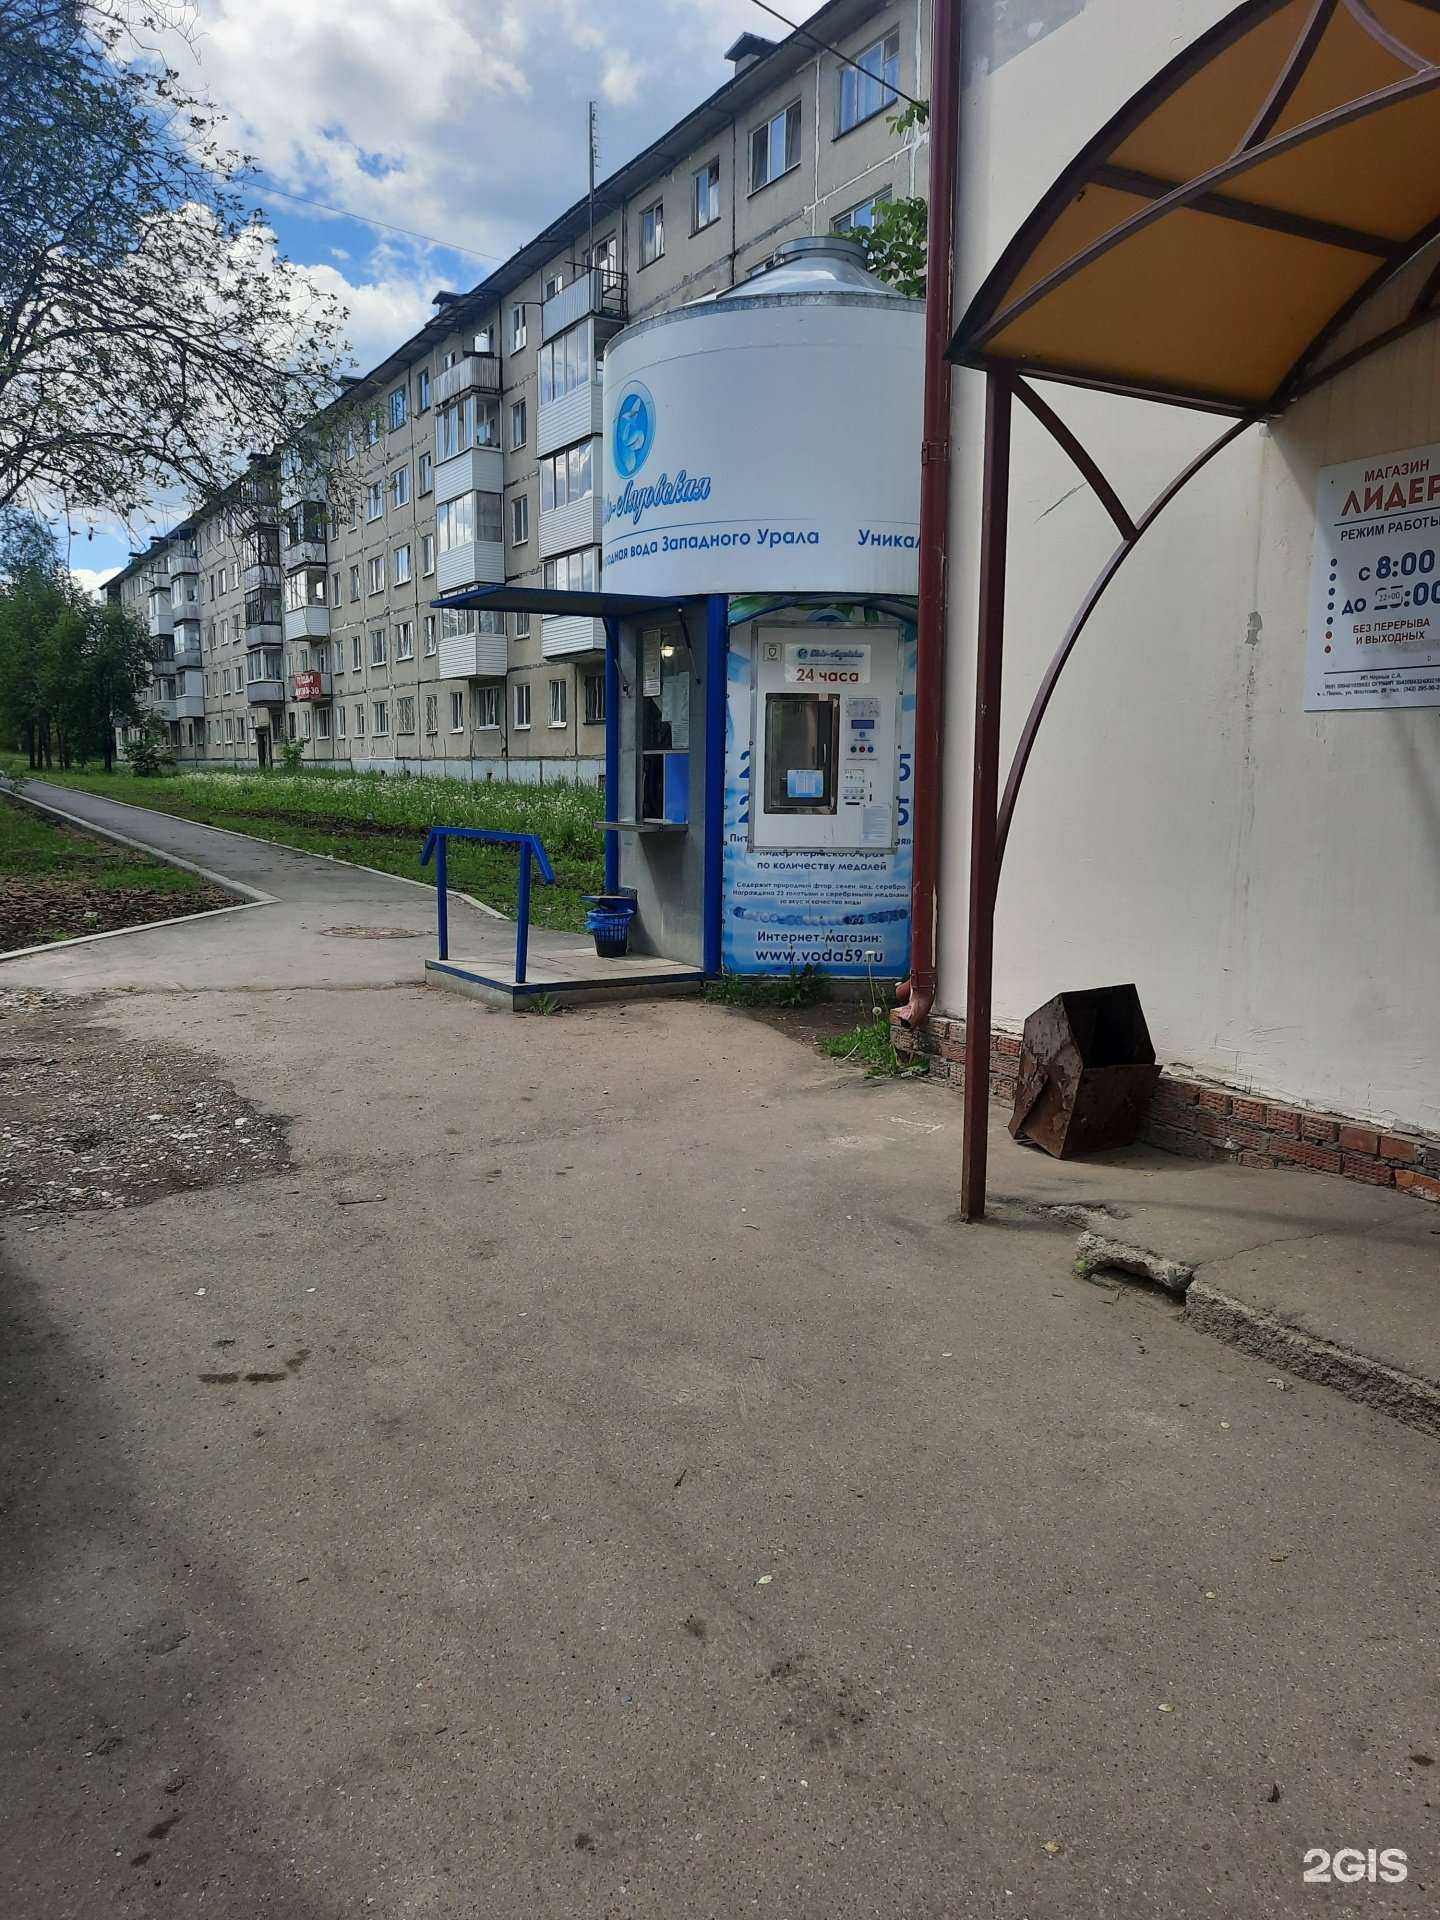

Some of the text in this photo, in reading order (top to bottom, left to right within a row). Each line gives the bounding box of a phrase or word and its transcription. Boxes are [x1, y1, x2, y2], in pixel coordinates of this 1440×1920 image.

[1364, 459, 1430, 482] МАГАЗИН
[1341, 474, 1440, 517] ЛИДЕР
[1340, 514, 1440, 541] РЕЖИМ РАБОТЫ
[630, 541, 658, 558] вода
[662, 533, 751, 552] Западного
[757, 528, 820, 549] Урала
[1358, 549, 1436, 581] с 8:00
[1353, 617, 1431, 634] БЕЗ ПЕРЕРЫВА
[1356, 631, 1425, 645] И ВЫХОДНЫХ
[796, 668, 860, 683] 24 часа
[757, 861, 887, 872] по количеству медалей
[757, 931, 882, 944] Интернет-магазин:
